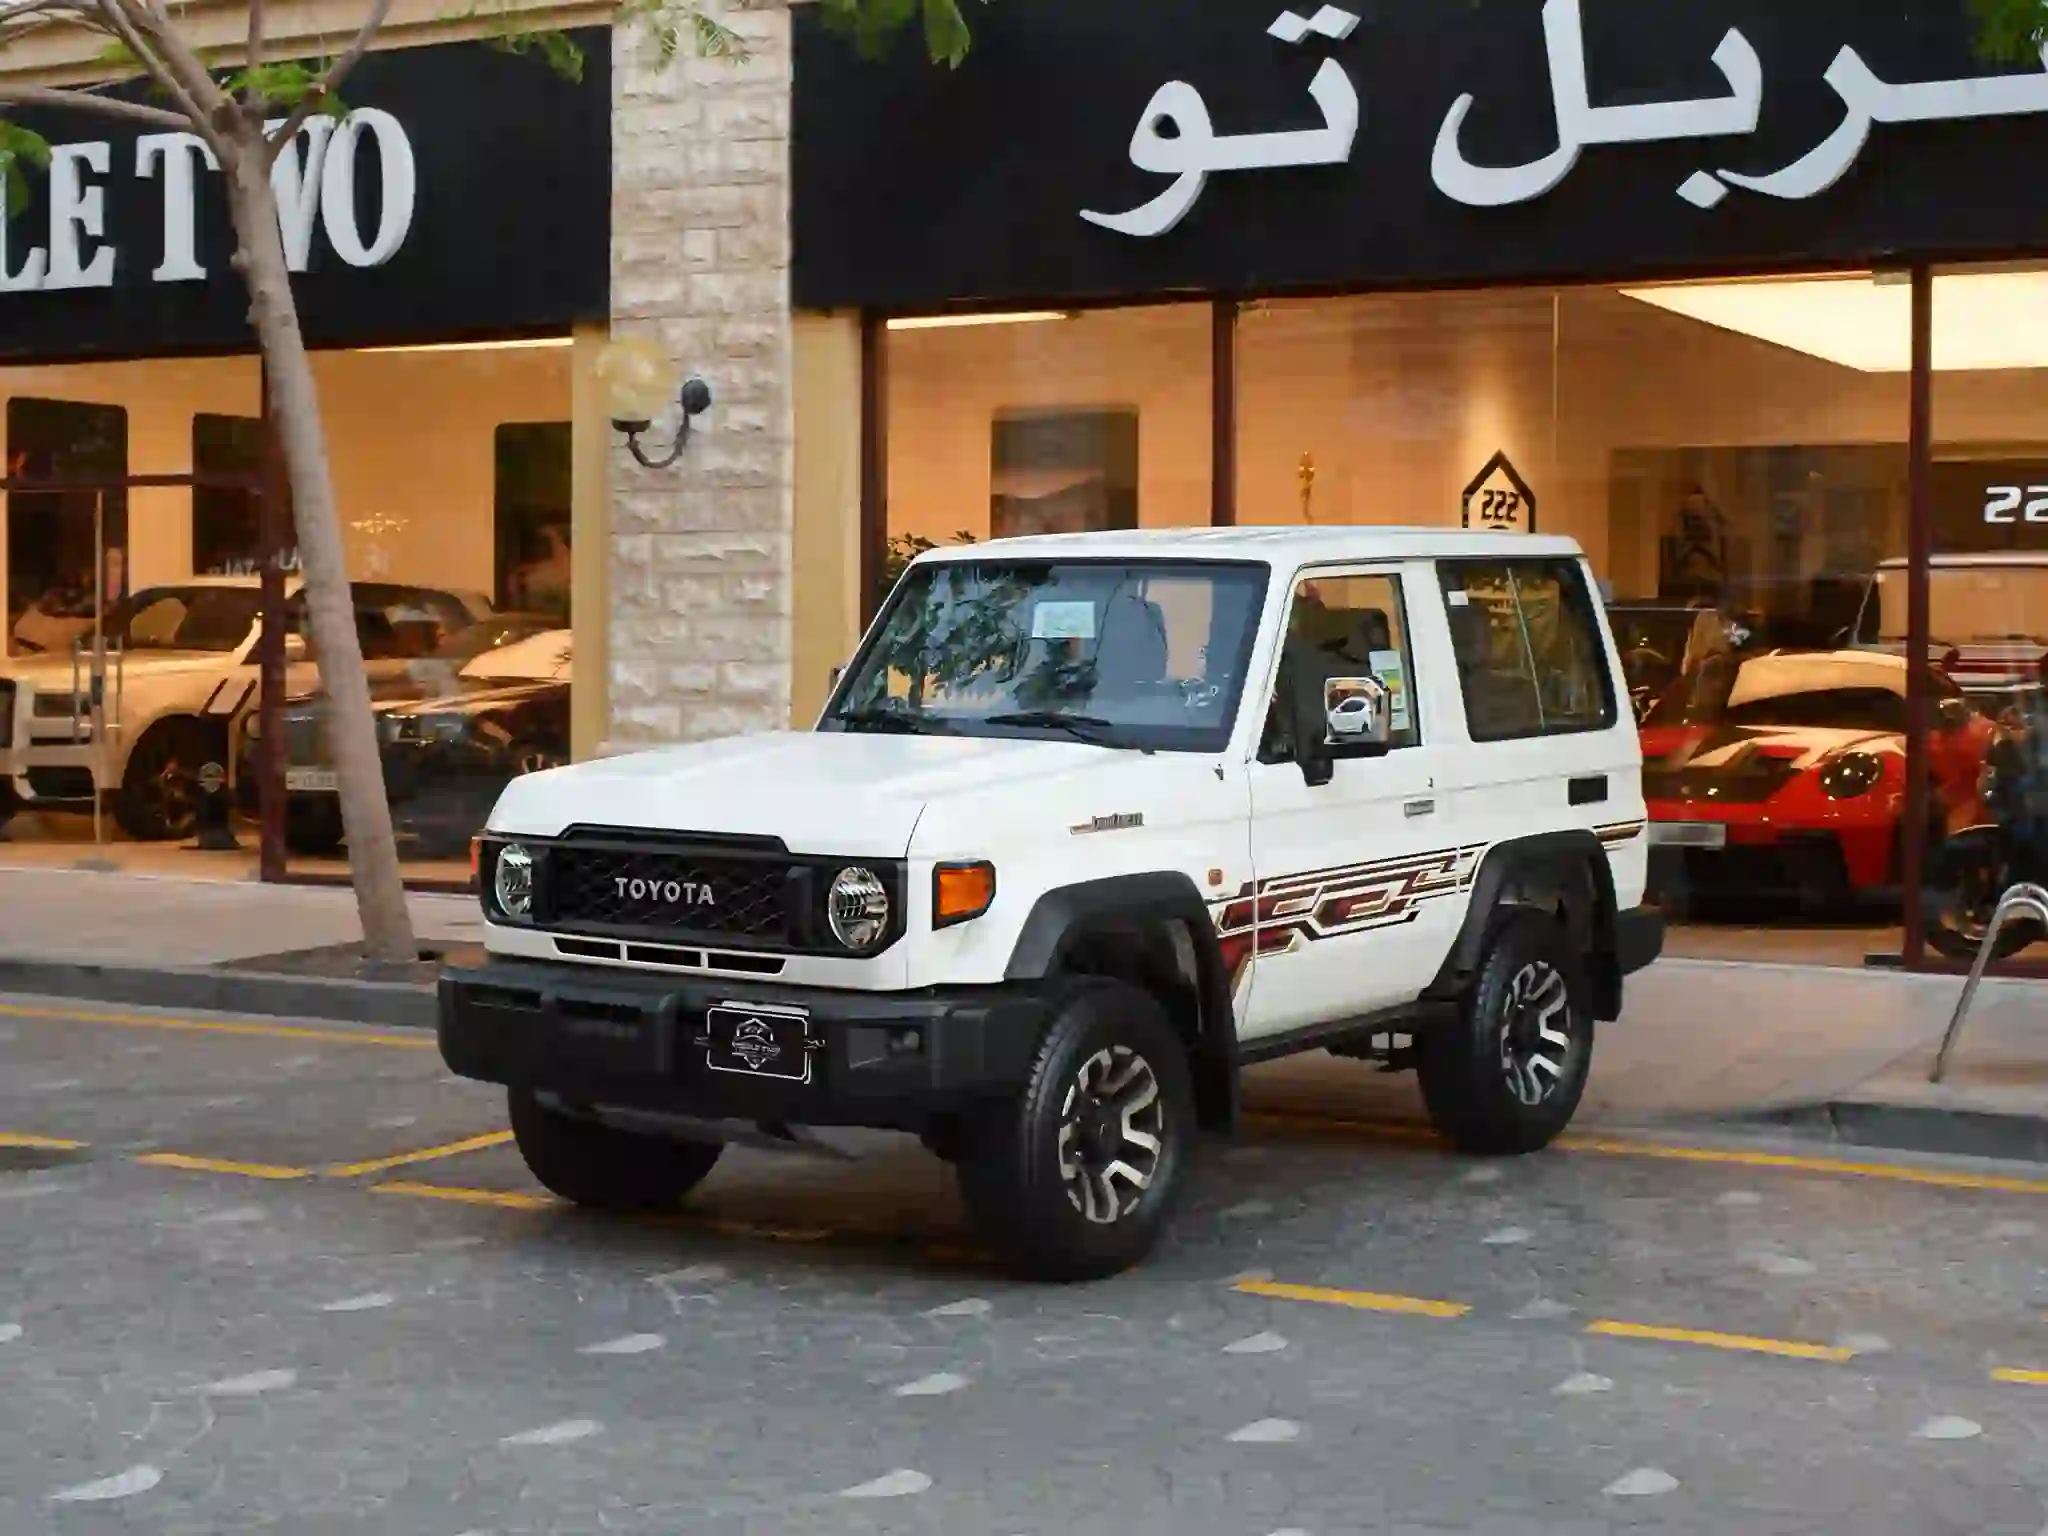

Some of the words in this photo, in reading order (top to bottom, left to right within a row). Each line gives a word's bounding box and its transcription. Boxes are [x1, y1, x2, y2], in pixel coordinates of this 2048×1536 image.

[1079, 4, 1361, 237] تو
[1431, 0, 2048, 209] ربل
[1481, 489, 1520, 522] 222
[1984, 485, 2048, 523] 22
[614, 876, 716, 906] TOYOTA
